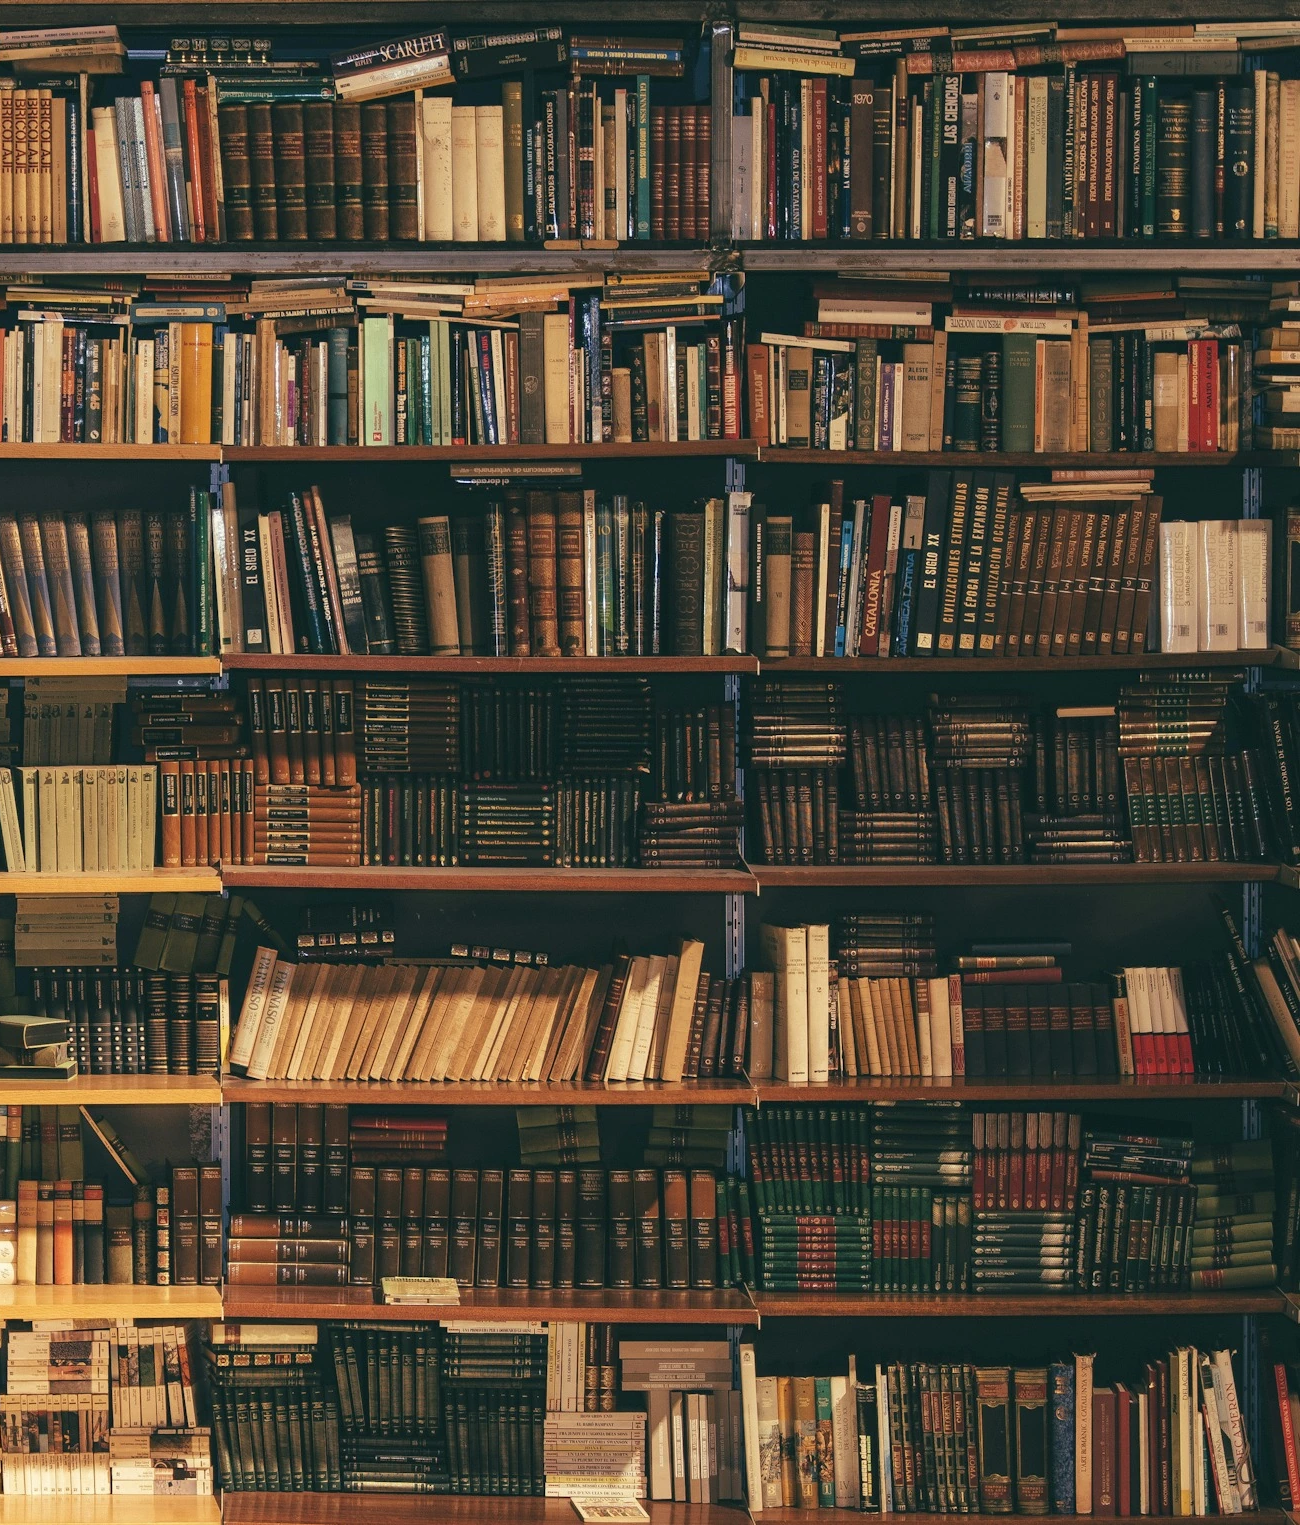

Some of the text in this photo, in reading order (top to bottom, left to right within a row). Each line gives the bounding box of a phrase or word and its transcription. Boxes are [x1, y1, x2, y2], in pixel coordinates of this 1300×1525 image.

[380, 32, 444, 62] SCARLETT
[788, 57, 803, 65] vida
[853, 94, 873, 104] 1970
[945, 77, 958, 121] CIENCIAS
[944, 126, 958, 144] LAS
[1080, 131, 1087, 141] DE
[792, 172, 799, 181] DE
[948, 177, 956, 206] ORGANICO
[950, 319, 1001, 329] PRESUNTO INOCENTE
[1206, 371, 1212, 380] AL
[724, 375, 736, 407] FREDERICK
[754, 370, 763, 422] "PAPILLON"
[397, 394, 406, 442] Dan Benson
[928, 534, 940, 546] XX
[943, 483, 968, 623] CIVILIZACIONES EXTINGUIDAS
[985, 486, 1008, 622] LA CIVILIZACIÓN OCCIDENTAL
[244, 530, 258, 584] EL SIGLO XX
[924, 552, 939, 575] SIGLO
[964, 488, 989, 622] LA ÉPOCA DE LA EXPANSIÓN
[865, 570, 881, 637] CATALONIA
[1273, 720, 1283, 746] ESPAÑA
[1278, 749, 1285, 759] DE
[1280, 761, 1292, 793] TESOROS
[248, 955, 272, 1010] PARNASO
[264, 970, 288, 1025] PARNASO
[842, 1406, 848, 1415] XX
[839, 1481, 851, 1490] IV
